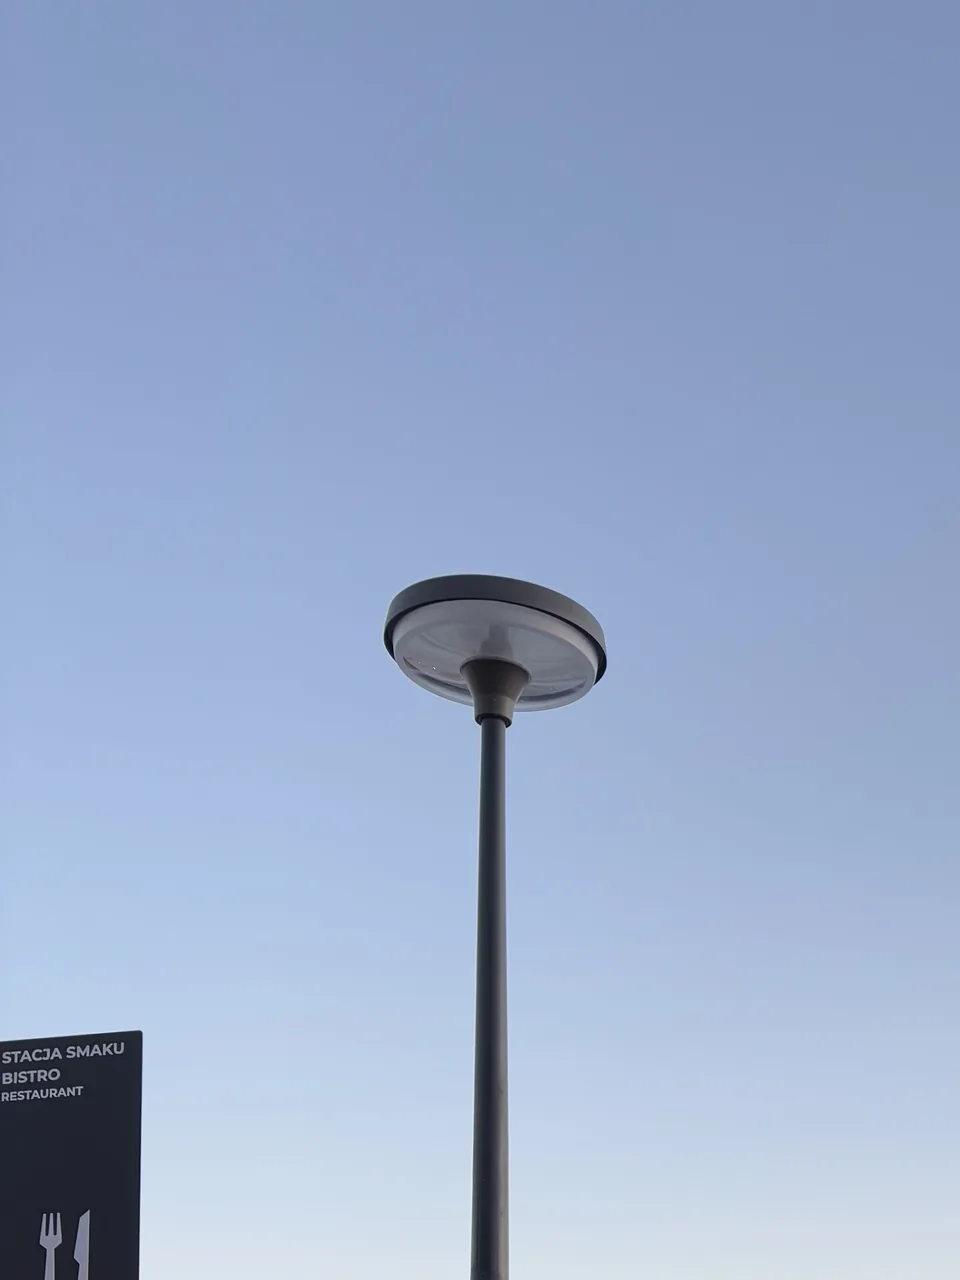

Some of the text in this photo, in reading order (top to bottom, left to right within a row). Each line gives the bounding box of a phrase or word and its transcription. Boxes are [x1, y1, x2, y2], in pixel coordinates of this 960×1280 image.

[2, 1042, 125, 1064] STACJA SMAKU
[2, 1068, 61, 1085] BISTRO
[1, 1086, 84, 1102] RESTAURANT
